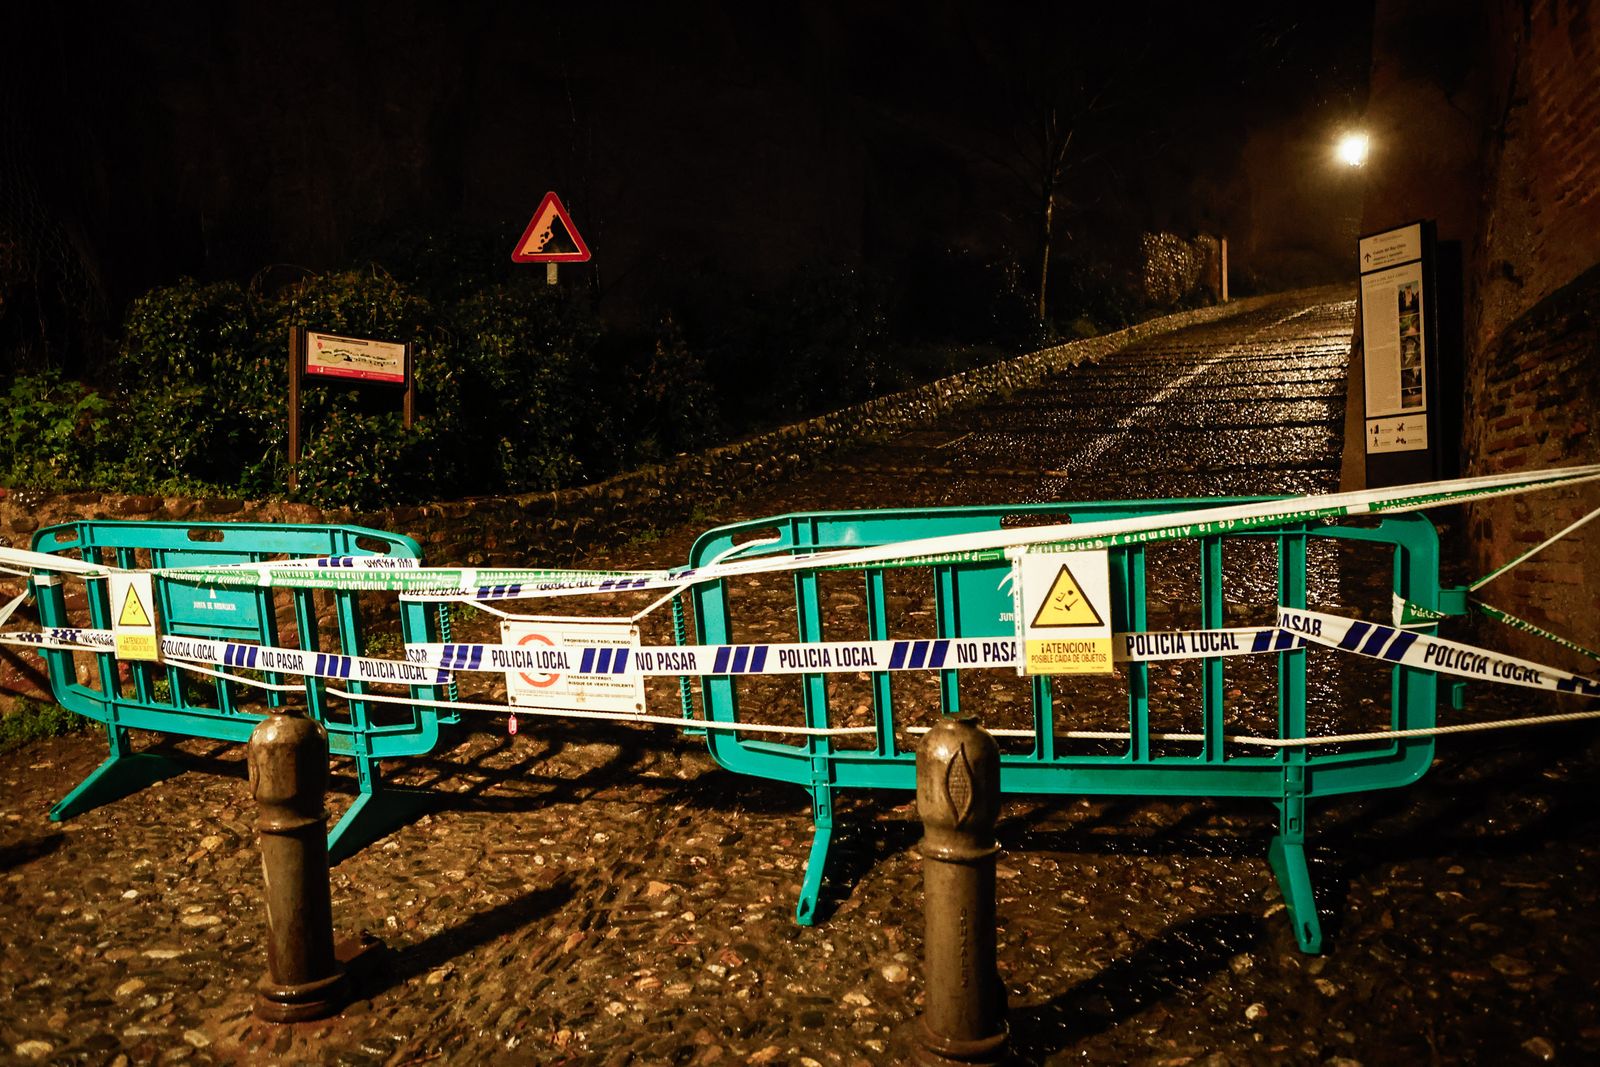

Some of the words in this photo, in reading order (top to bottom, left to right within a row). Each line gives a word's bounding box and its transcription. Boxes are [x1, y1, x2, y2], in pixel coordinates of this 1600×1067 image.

[1198, 523, 1211, 533] la
[1218, 520, 1234, 530] de
[1110, 536, 1118, 546] y
[1124, 526, 1191, 546] Alhambra
[913, 552, 978, 564] Patronato
[326, 571, 365, 580] Alhambra
[380, 572, 391, 581] de
[161, 640, 191, 655] POLICIA
[192, 643, 218, 661] LOCAL
[1041, 642, 1096, 654] ¡ATENCION!
[1125, 634, 1186, 656] POLICIA
[1190, 631, 1239, 653] LOCAL
[261, 651, 274, 668] NO
[276, 653, 304, 671] PASAR
[492, 650, 533, 669] POLICIA
[536, 650, 571, 670] LOCAL
[635, 652, 653, 671] NO
[657, 652, 697, 671] PASAR
[779, 648, 832, 668] POLICIA
[835, 646, 878, 667] LOCAL
[956, 643, 978, 664] NO
[1031, 654, 1054, 664] POSIBLE
[1073, 654, 1080, 663] DE
[1080, 653, 1107, 663] OBJETOS
[359, 661, 396, 679] POLICIA
[397, 664, 428, 680] LOCAL
[1424, 642, 1488, 675] POLICIA
[1492, 660, 1543, 685] LOCAL
